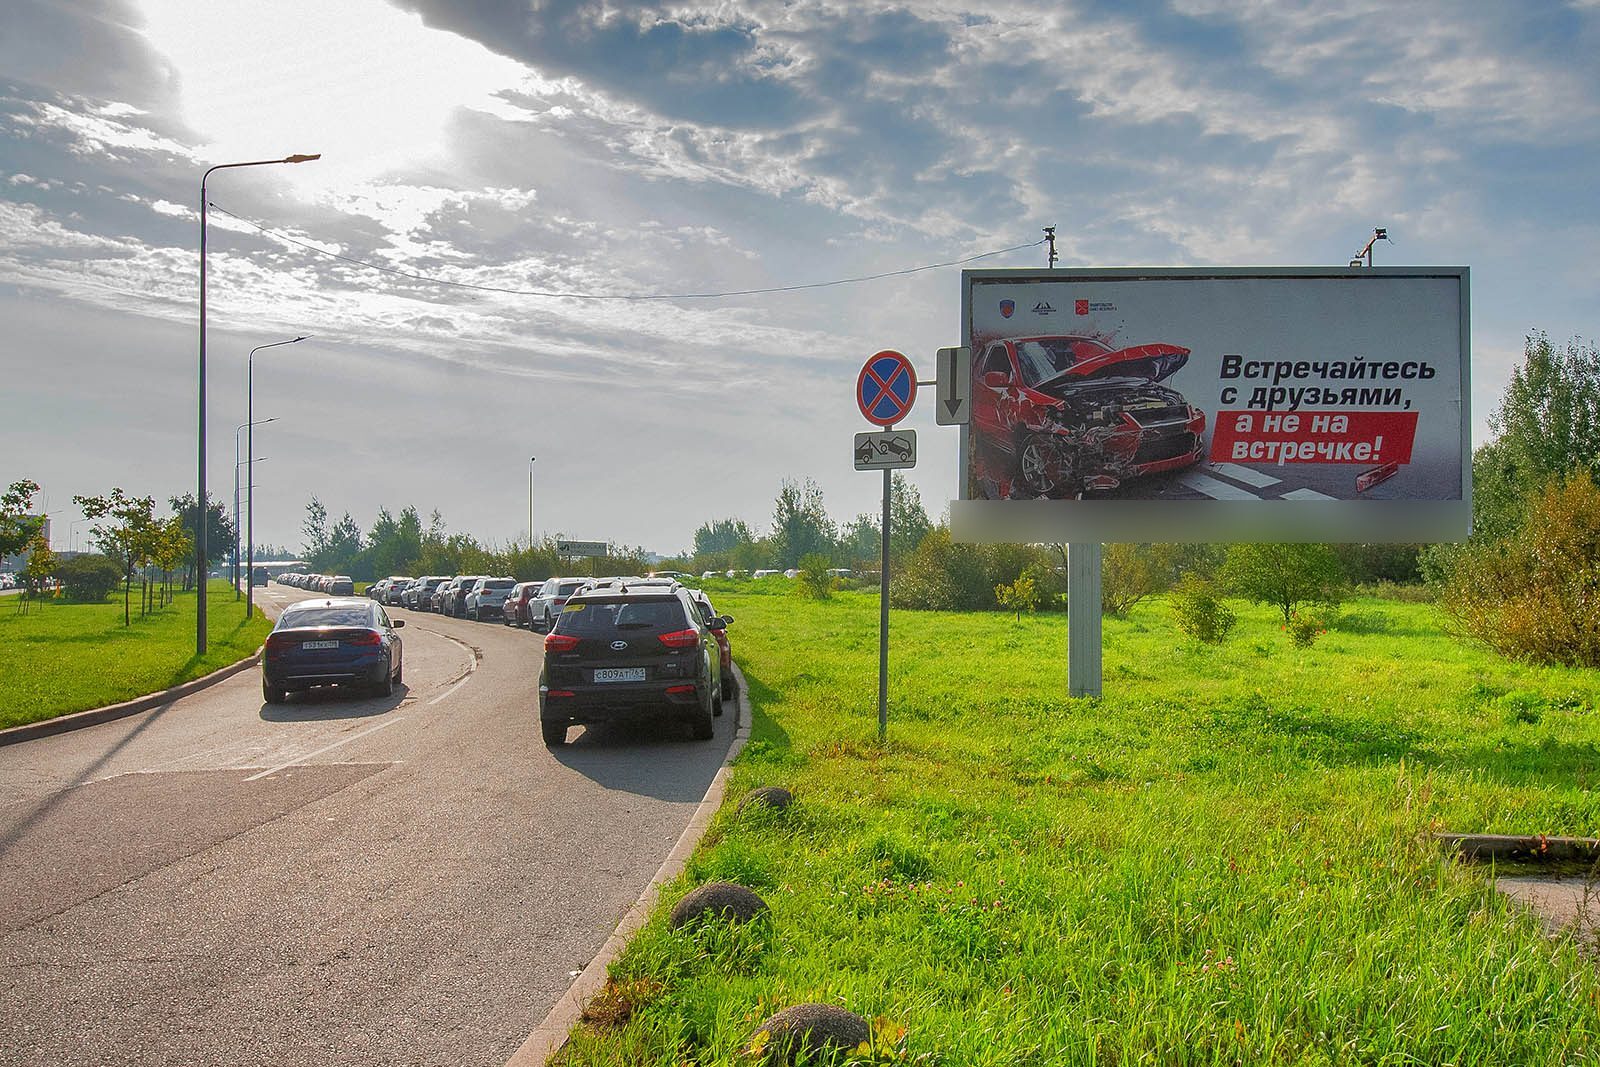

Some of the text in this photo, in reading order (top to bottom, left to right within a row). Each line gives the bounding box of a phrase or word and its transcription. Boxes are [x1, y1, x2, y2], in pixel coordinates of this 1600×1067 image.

[1220, 355, 1436, 386] Встречайтесь
[1221, 387, 1412, 412] с друзьями,
[1235, 415, 1349, 433] а не на
[1232, 436, 1383, 466] встречке!
